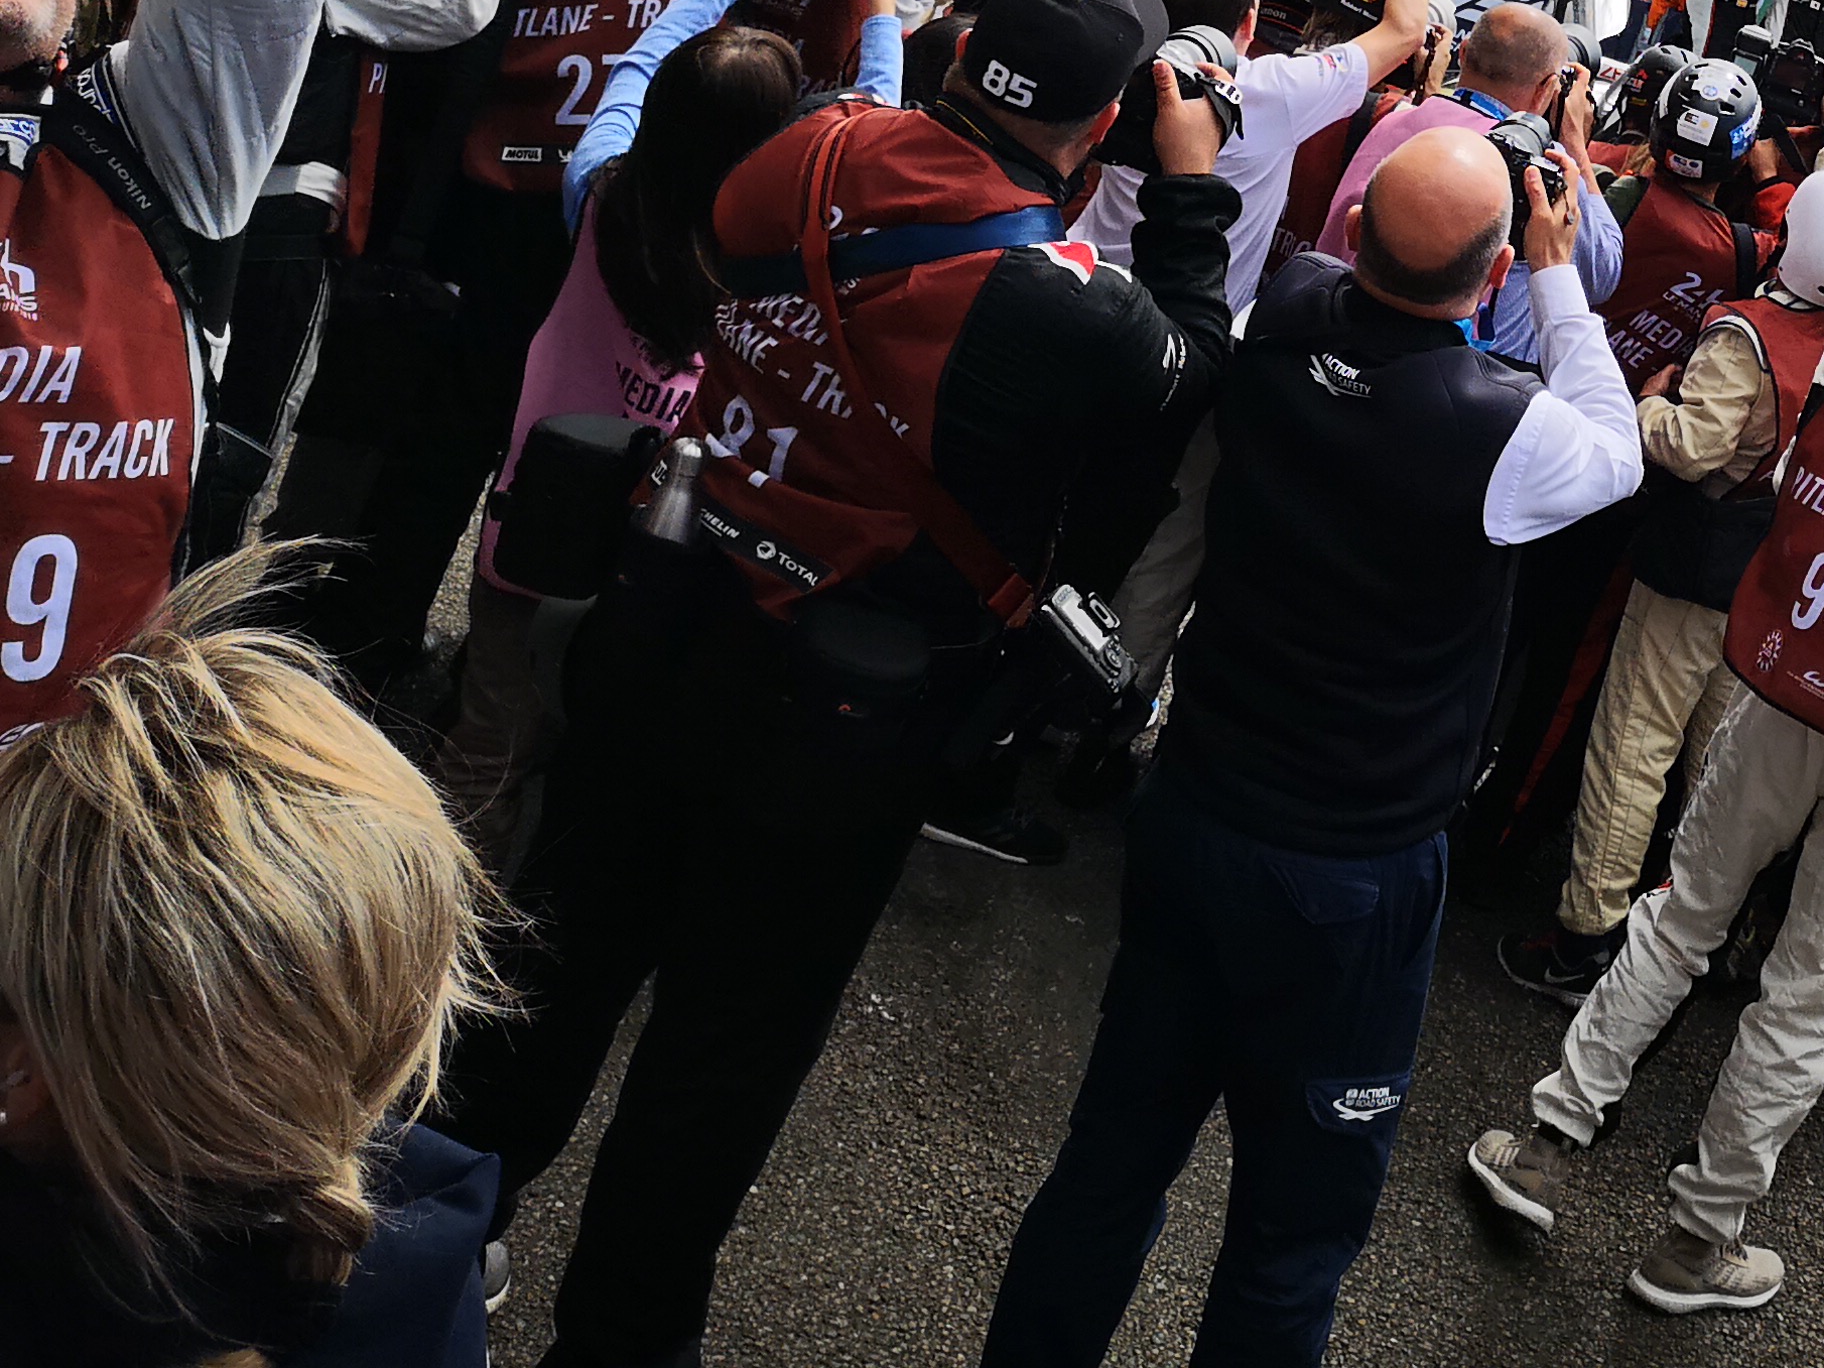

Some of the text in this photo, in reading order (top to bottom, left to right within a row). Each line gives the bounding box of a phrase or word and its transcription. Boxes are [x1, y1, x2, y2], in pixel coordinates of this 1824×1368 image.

[514, 3, 599, 38] TLANE
[1260, 6, 1287, 20] anon
[555, 53, 626, 126] 2
[981, 59, 1038, 108] 85
[72, 124, 108, 155] Pro
[505, 149, 539, 161] MOTUL
[107, 156, 151, 210] Nikon
[1676, 300, 1701, 320] MAN
[0, 345, 82, 404] DIA
[1325, 355, 1360, 380] ACTION
[1339, 378, 1372, 395] SAFETY
[35, 418, 173, 481] TRACK
[700, 508, 740, 538] CHELIN
[778, 552, 819, 587] TOTAL
[1, 534, 77, 682] 9
